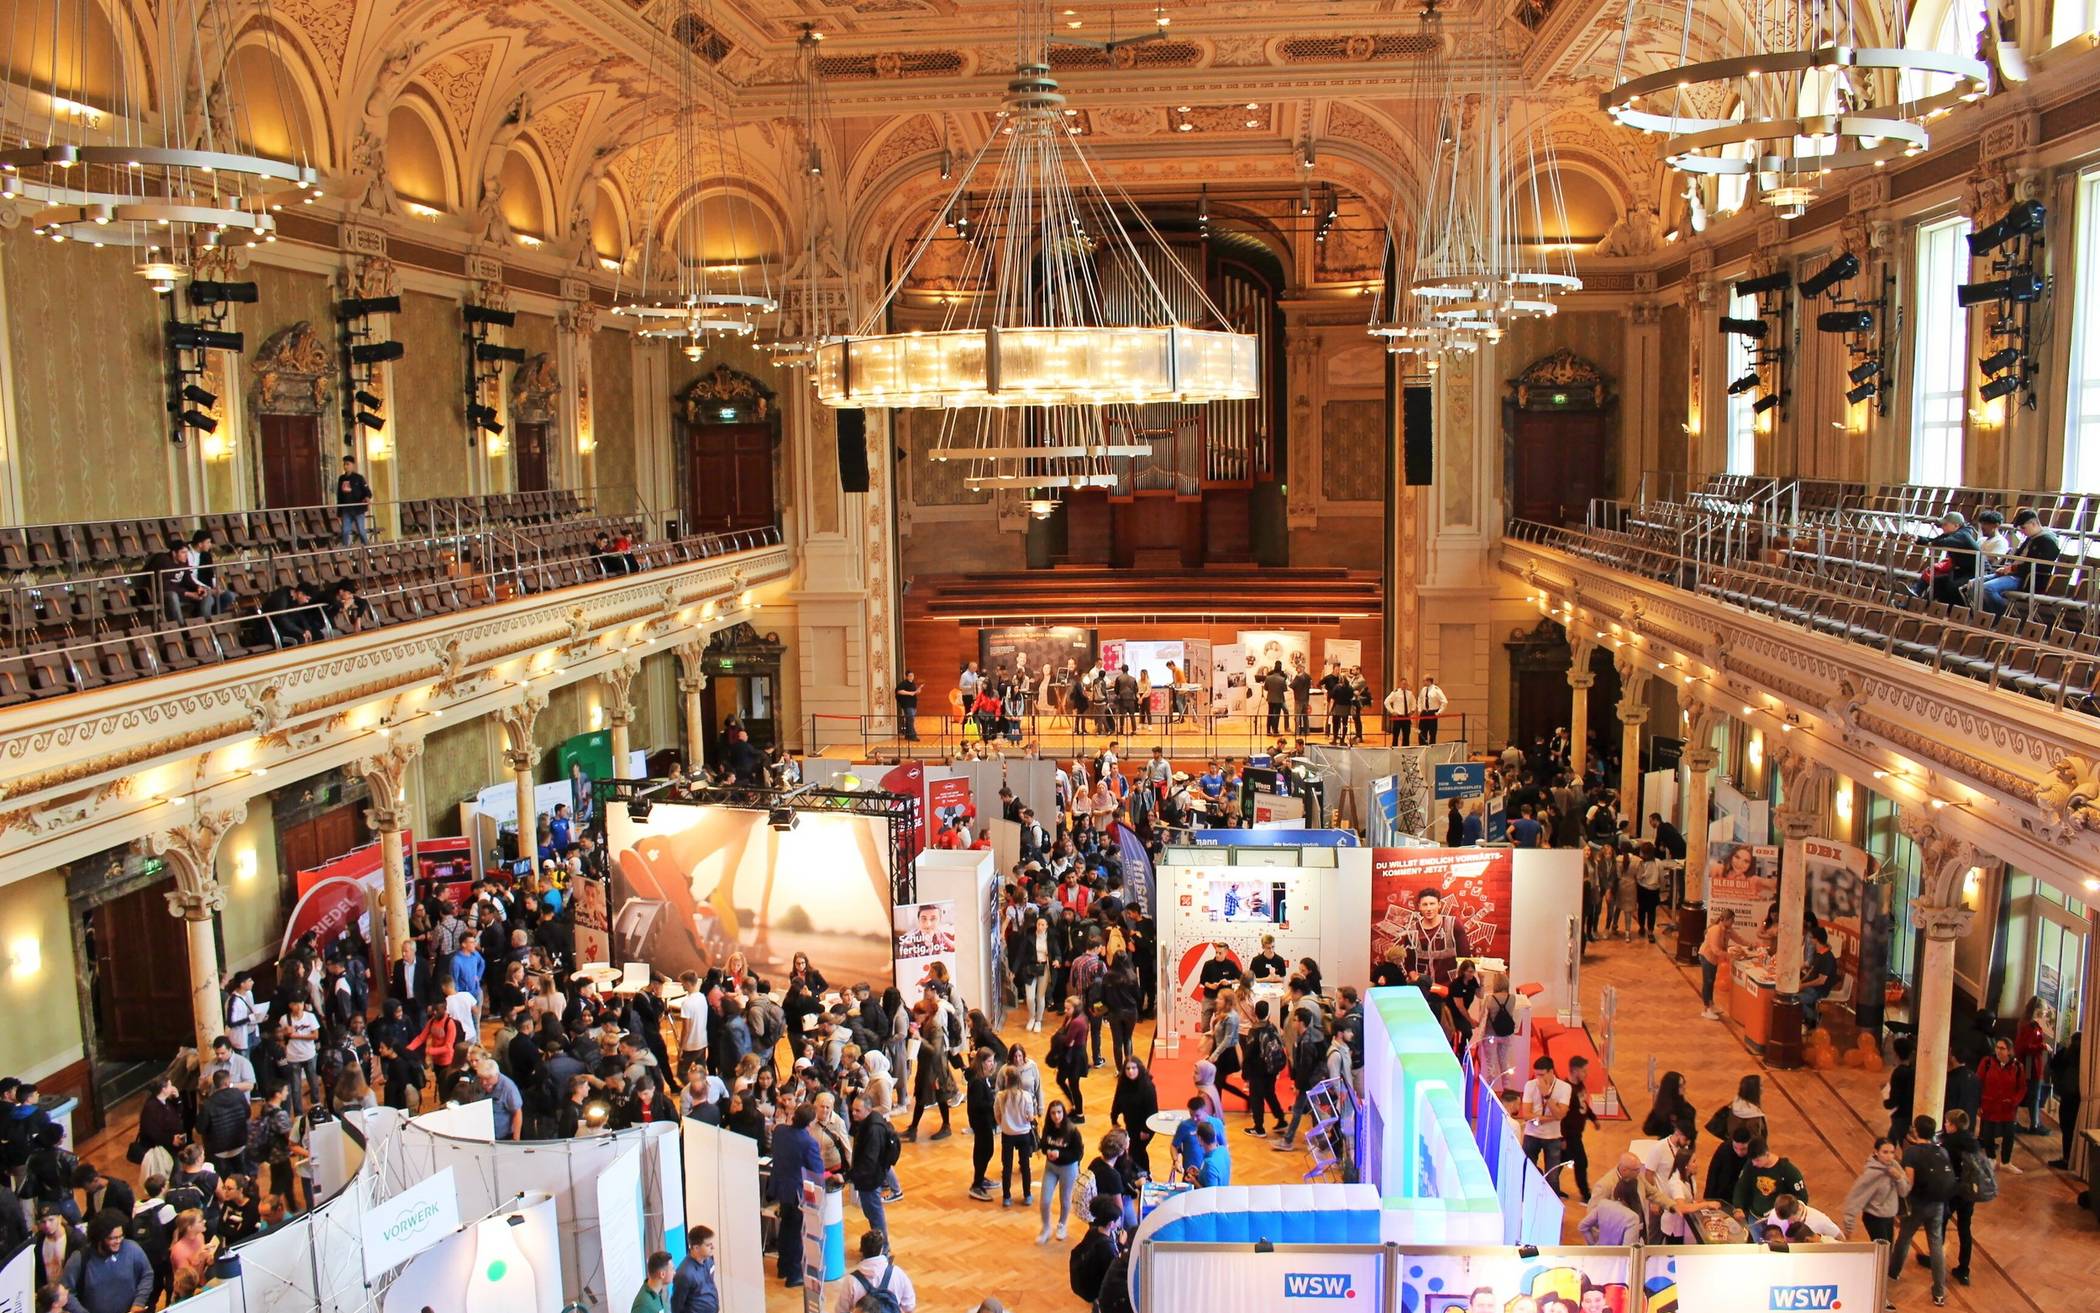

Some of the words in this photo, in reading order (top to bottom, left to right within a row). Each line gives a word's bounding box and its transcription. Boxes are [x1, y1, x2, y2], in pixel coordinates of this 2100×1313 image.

[1376, 862, 1388, 870] DU
[1389, 860, 1417, 869] WILLST
[1419, 856, 1454, 867] ENDLICH
[1382, 868, 1423, 877] KOMMEN?
[1423, 865, 1447, 874] JETZT
[312, 896, 359, 938] RIEDEL
[383, 1201, 440, 1241] VORWERK
[1288, 1276, 1345, 1296] WSW
[1773, 1288, 1831, 1308] WSW
